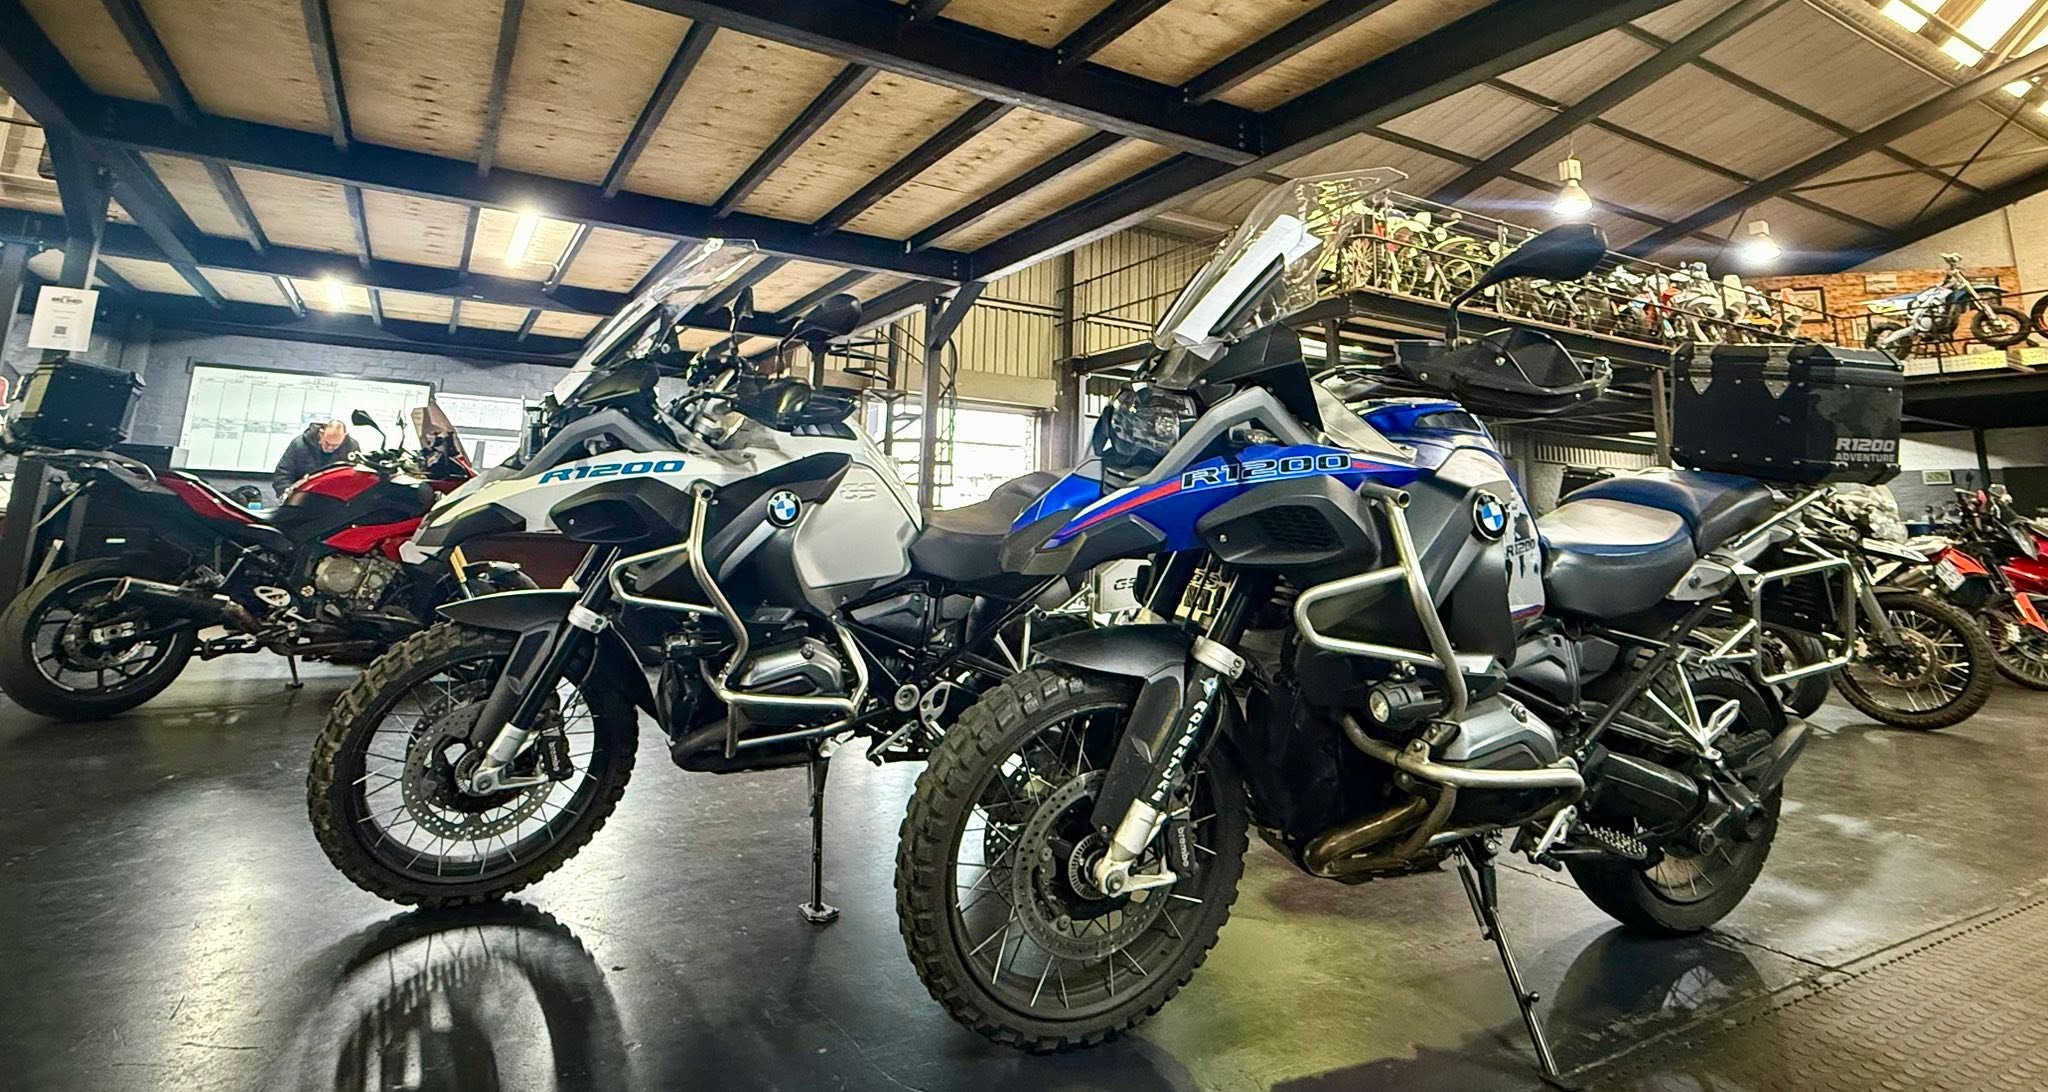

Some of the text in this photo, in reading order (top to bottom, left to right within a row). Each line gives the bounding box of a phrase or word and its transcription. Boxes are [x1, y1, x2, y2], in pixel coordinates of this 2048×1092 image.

[1835, 438, 1896, 452] R1200
[1835, 452, 1896, 463] ADVENTURE
[538, 460, 686, 485] R1200
[1181, 453, 1351, 490] R1200
[1151, 700, 1209, 802] ADVENTURE
[1177, 826, 1190, 868] brembo
